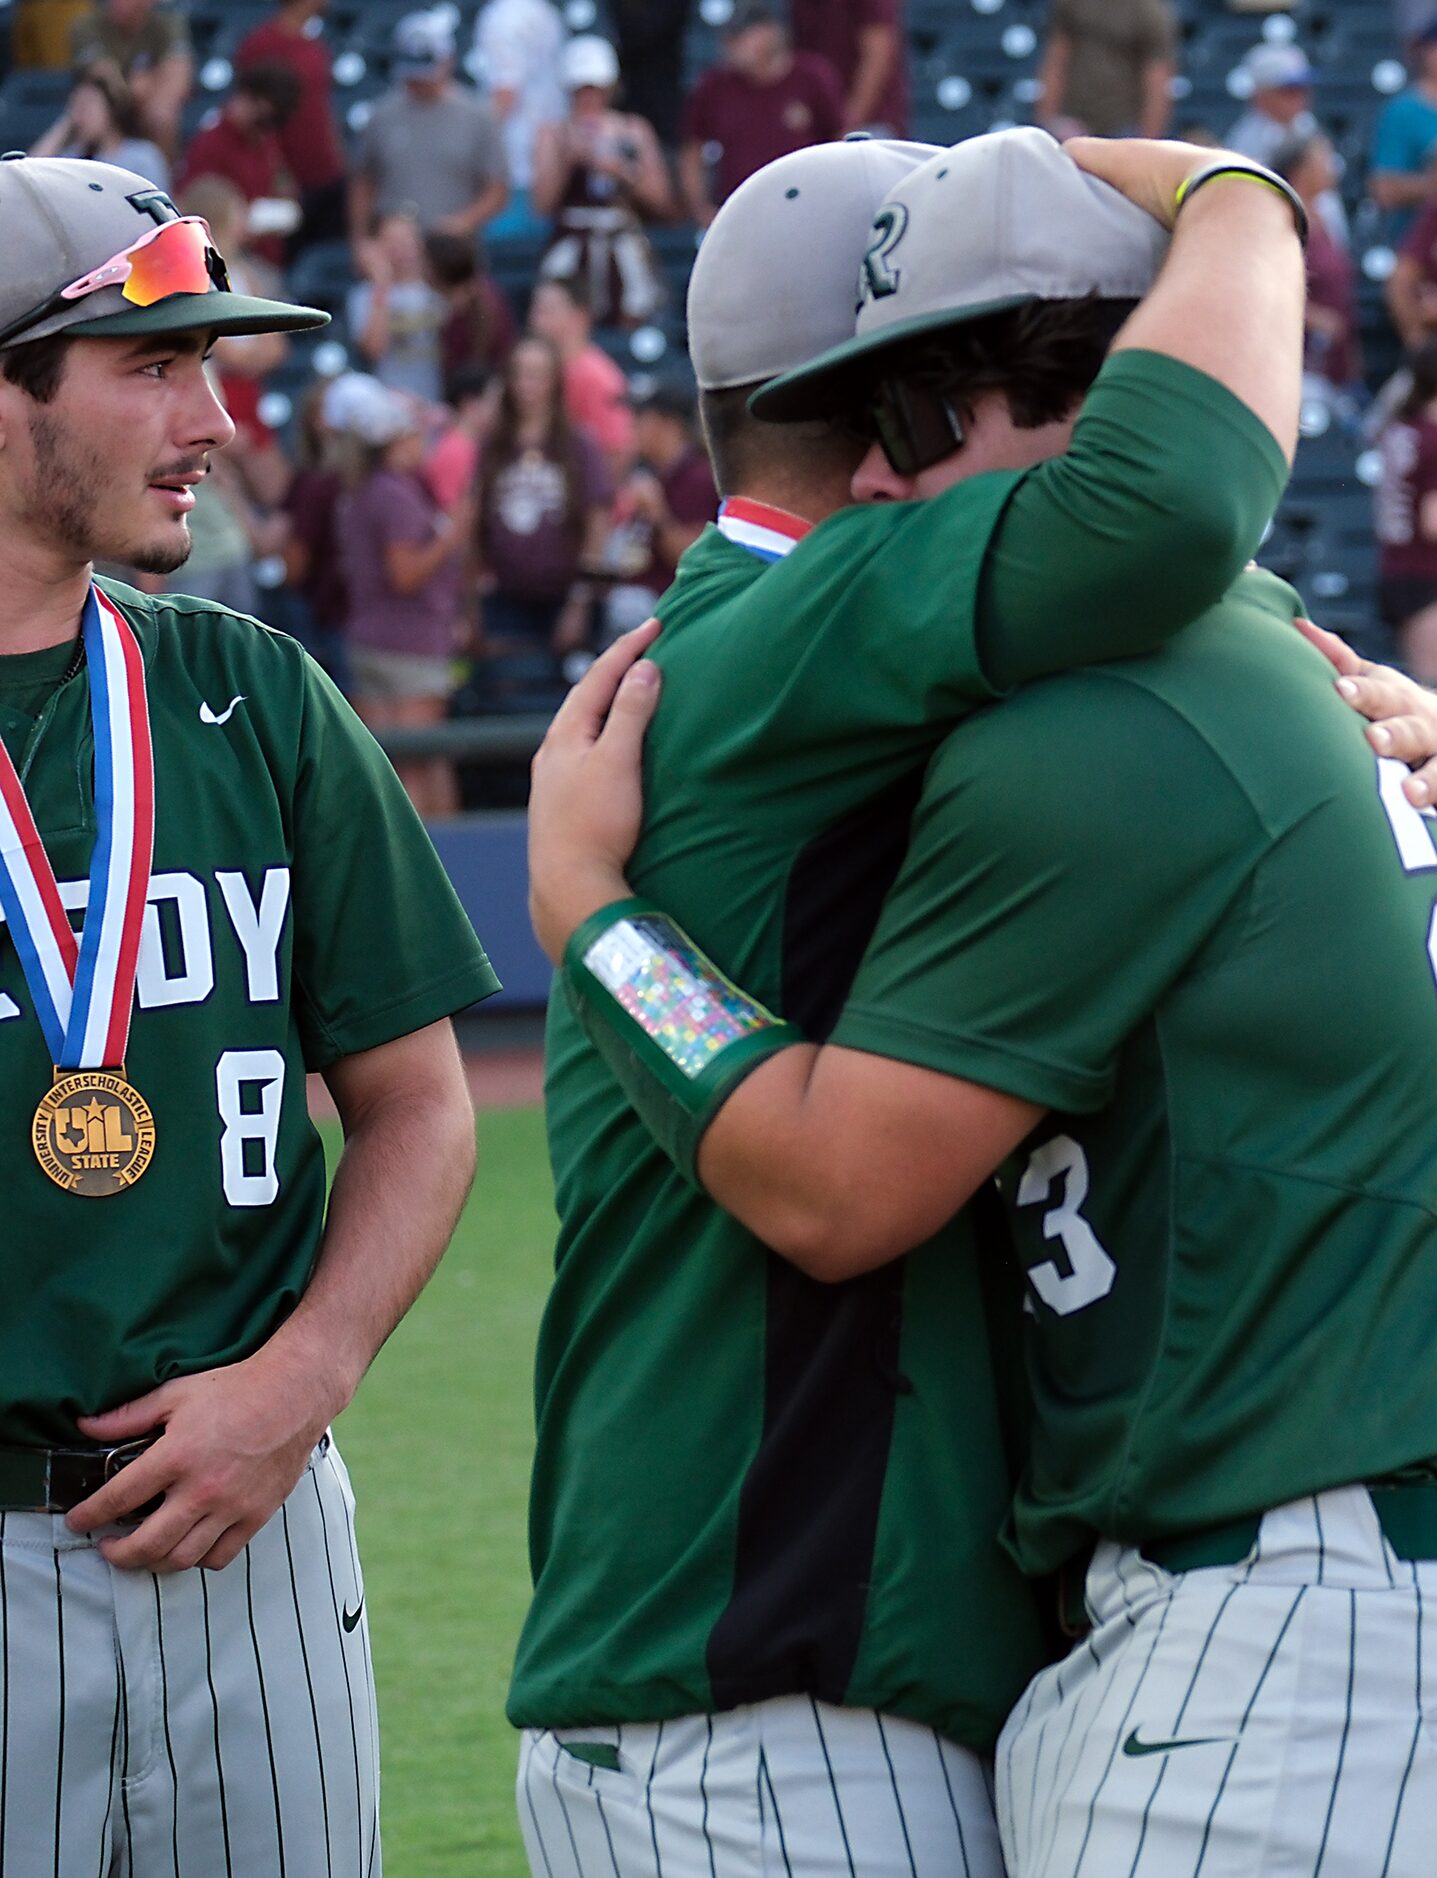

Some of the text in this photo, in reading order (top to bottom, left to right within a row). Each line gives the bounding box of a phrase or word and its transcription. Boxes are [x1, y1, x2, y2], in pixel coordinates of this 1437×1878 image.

[34, 1074, 153, 1186] UNIVERSITY INTERSCHOLASTIC LEAGUE
[71, 1153, 121, 1170] STATE
[215, 1048, 286, 1207] 8
[1015, 1133, 1118, 1318] 3
